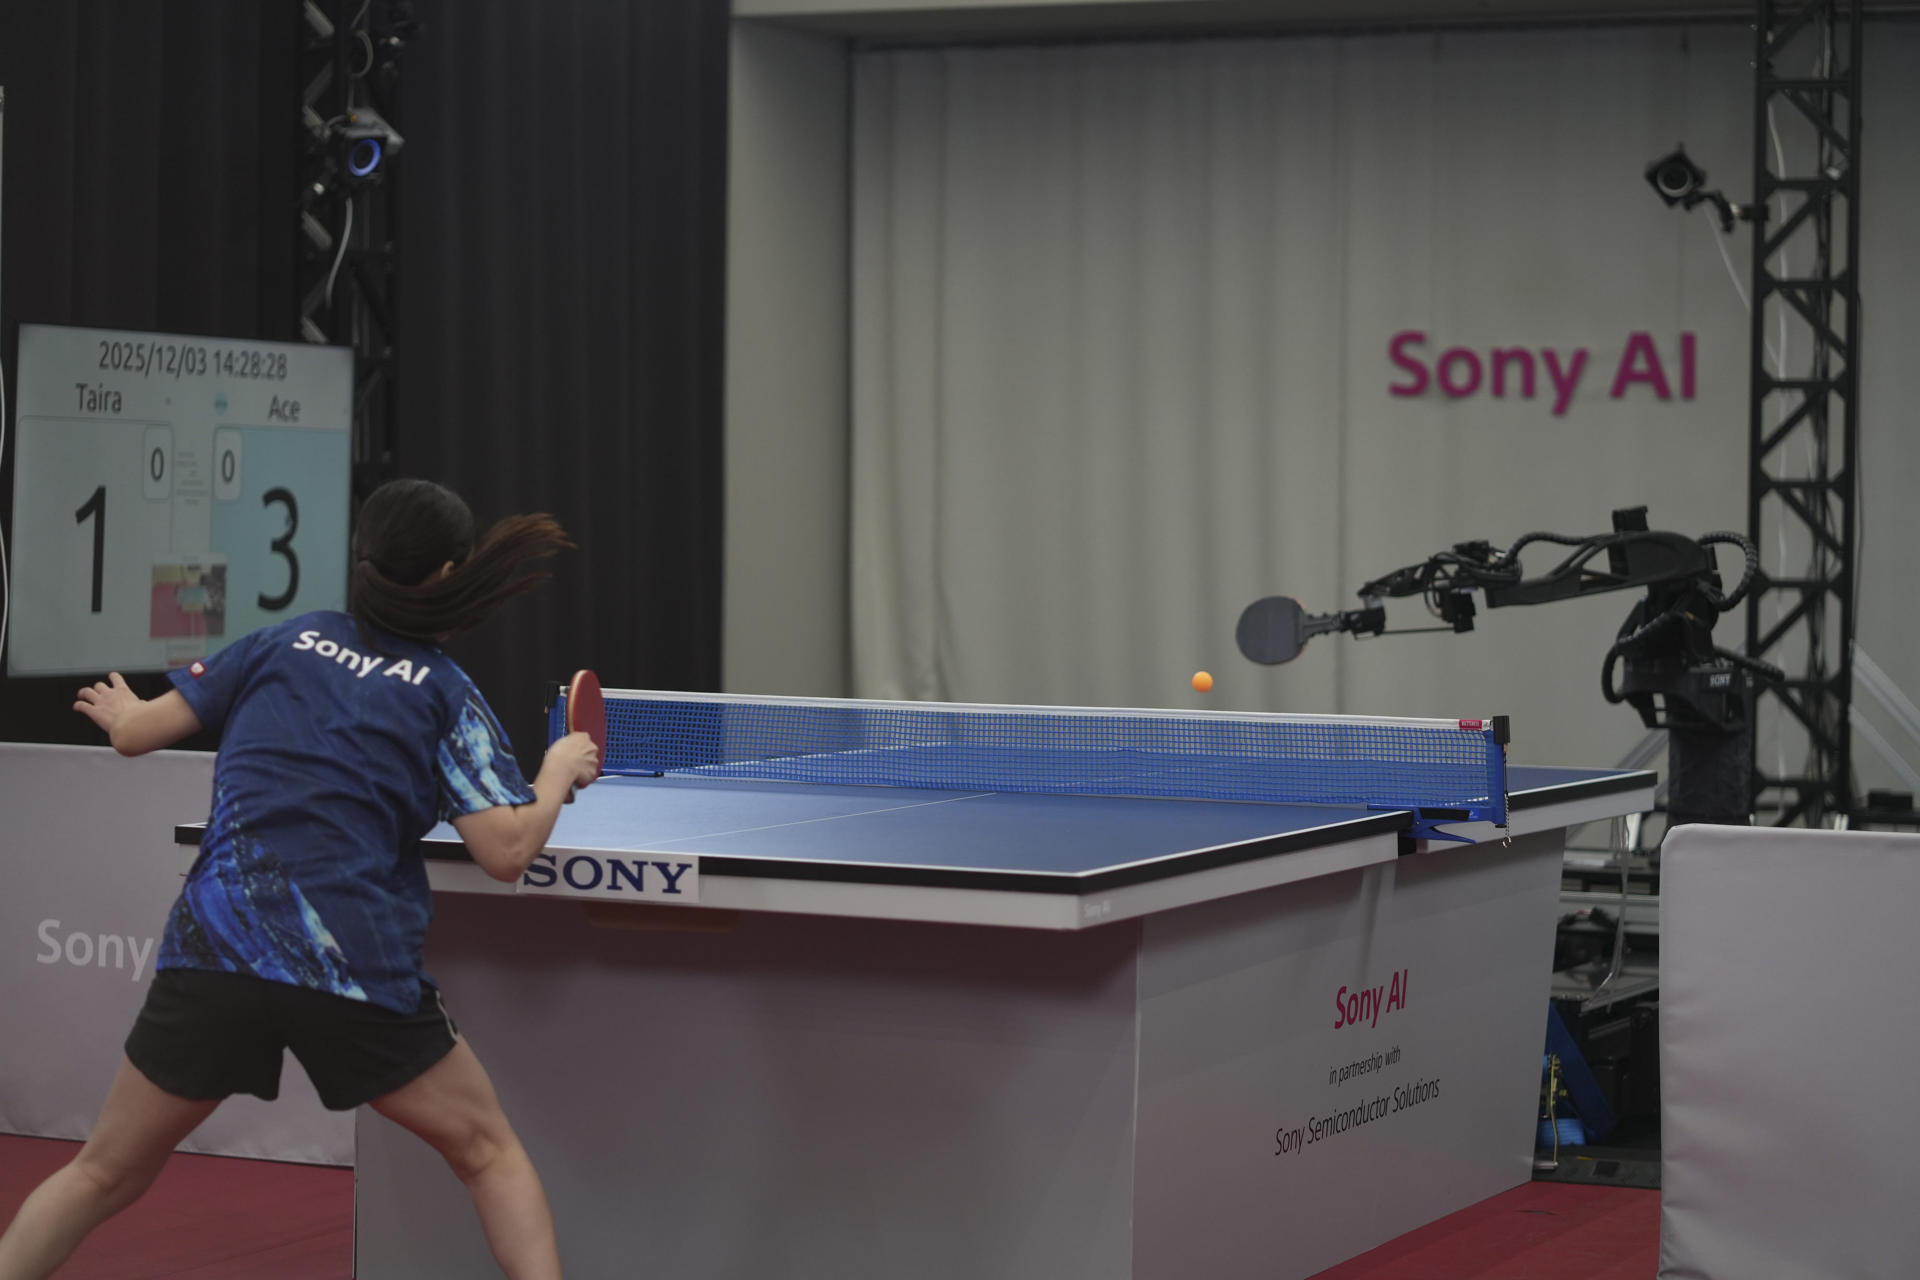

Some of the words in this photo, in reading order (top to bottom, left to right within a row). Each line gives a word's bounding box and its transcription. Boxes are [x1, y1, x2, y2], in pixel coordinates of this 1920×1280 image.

[99, 340, 207, 378] 2025/12/03
[214, 350, 288, 380] 14:28:28
[1388, 329, 1588, 416] Sony
[1609, 331, 1696, 400] AI
[75, 383, 122, 413] Taira
[268, 395, 301, 422] Ace
[150, 447, 164, 481] 0
[221, 450, 235, 483] 0
[75, 485, 106, 613] 1
[257, 486, 299, 612] 3
[293, 630, 384, 678] Sony
[383, 659, 430, 685] AI
[523, 853, 692, 894] SONY
[36, 918, 154, 982] Sony
[1334, 985, 1384, 1030] Sony
[1386, 969, 1408, 1013] AI
[1329, 1066, 1337, 1085] in
[1338, 1052, 1383, 1087] partnership
[1385, 1045, 1401, 1066] with
[1275, 1125, 1305, 1156] Sony
[1307, 1096, 1391, 1144] Semiconductor
[1392, 1078, 1440, 1113] Solutions
